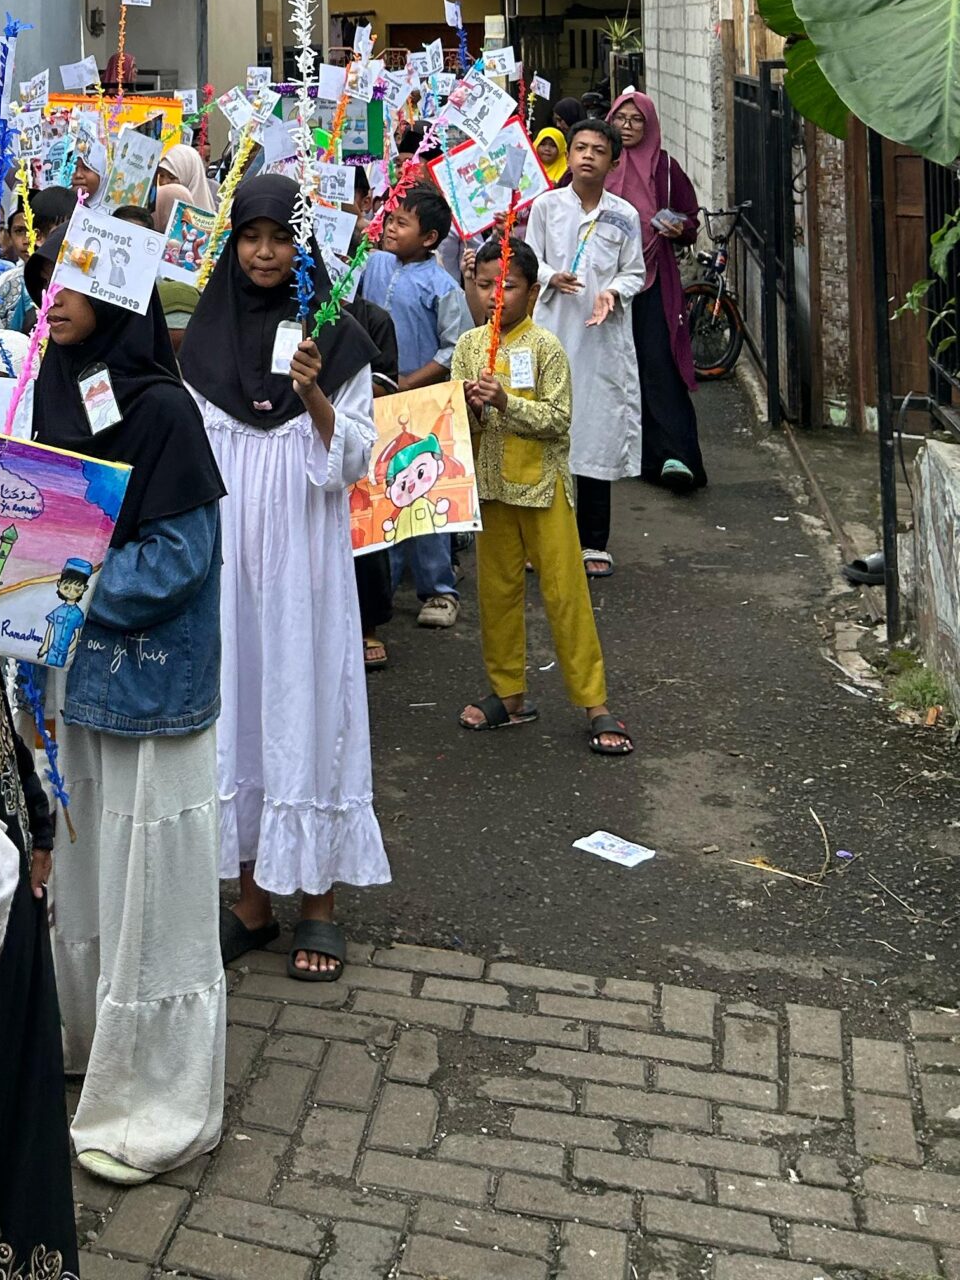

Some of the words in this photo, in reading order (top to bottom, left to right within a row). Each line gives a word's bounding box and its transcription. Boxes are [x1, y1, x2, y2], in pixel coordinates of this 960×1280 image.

[81, 217, 133, 248] Semangat
[192, 214, 215, 226] MARHA
[90, 280, 140, 310] Berpuasa
